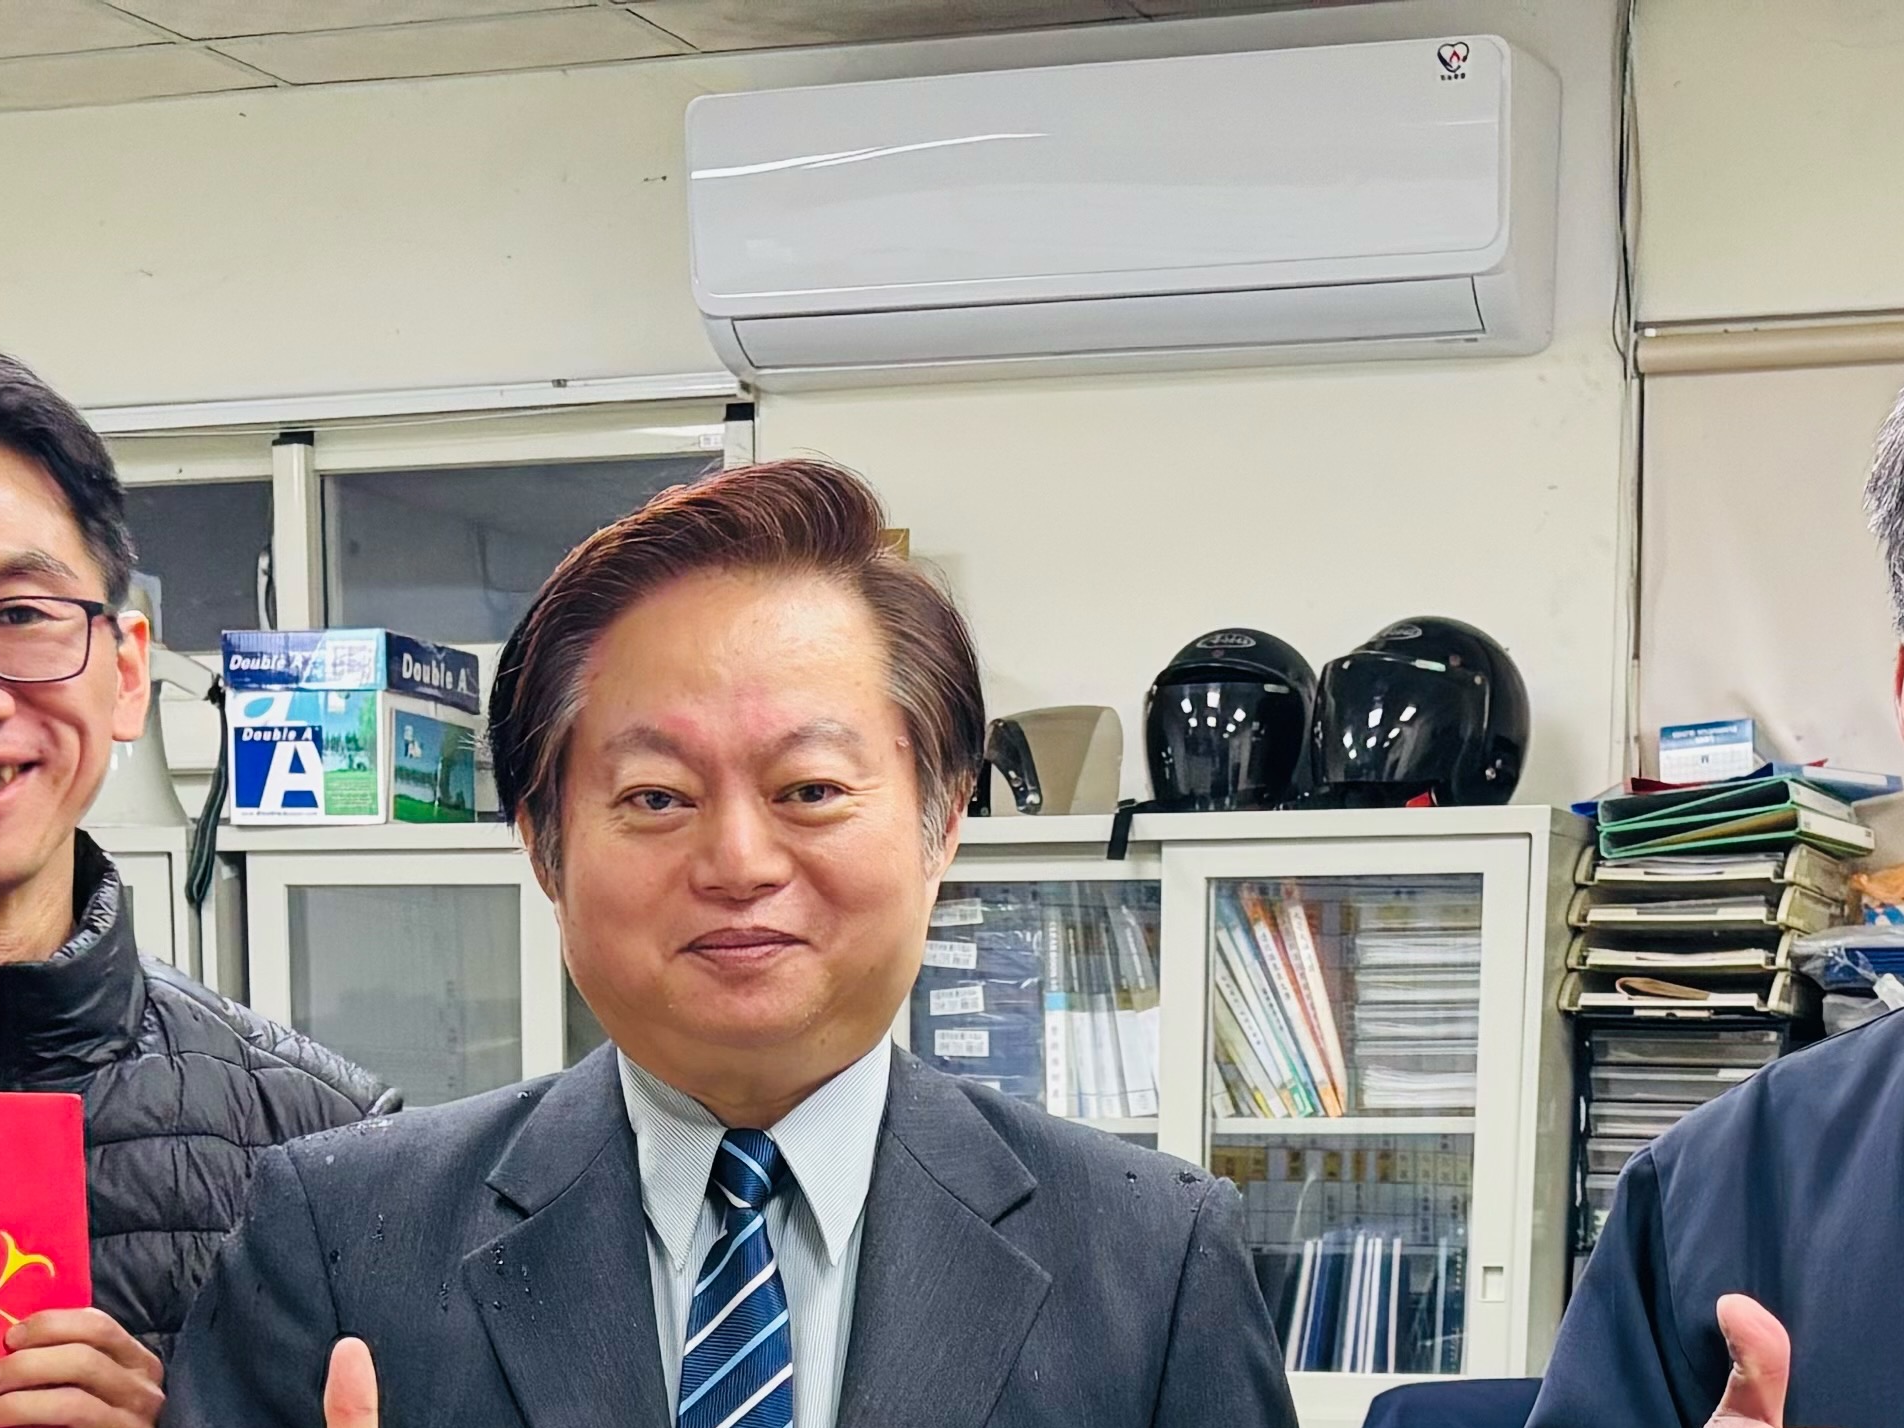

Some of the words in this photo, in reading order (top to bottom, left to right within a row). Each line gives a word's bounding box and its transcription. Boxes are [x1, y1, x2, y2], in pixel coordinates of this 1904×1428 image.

[229, 653, 286, 671] Double
[401, 652, 455, 690] Double
[457, 667, 468, 691] A
[241, 727, 297, 742] Double
[301, 729, 313, 741] A
[259, 740, 325, 808] A
